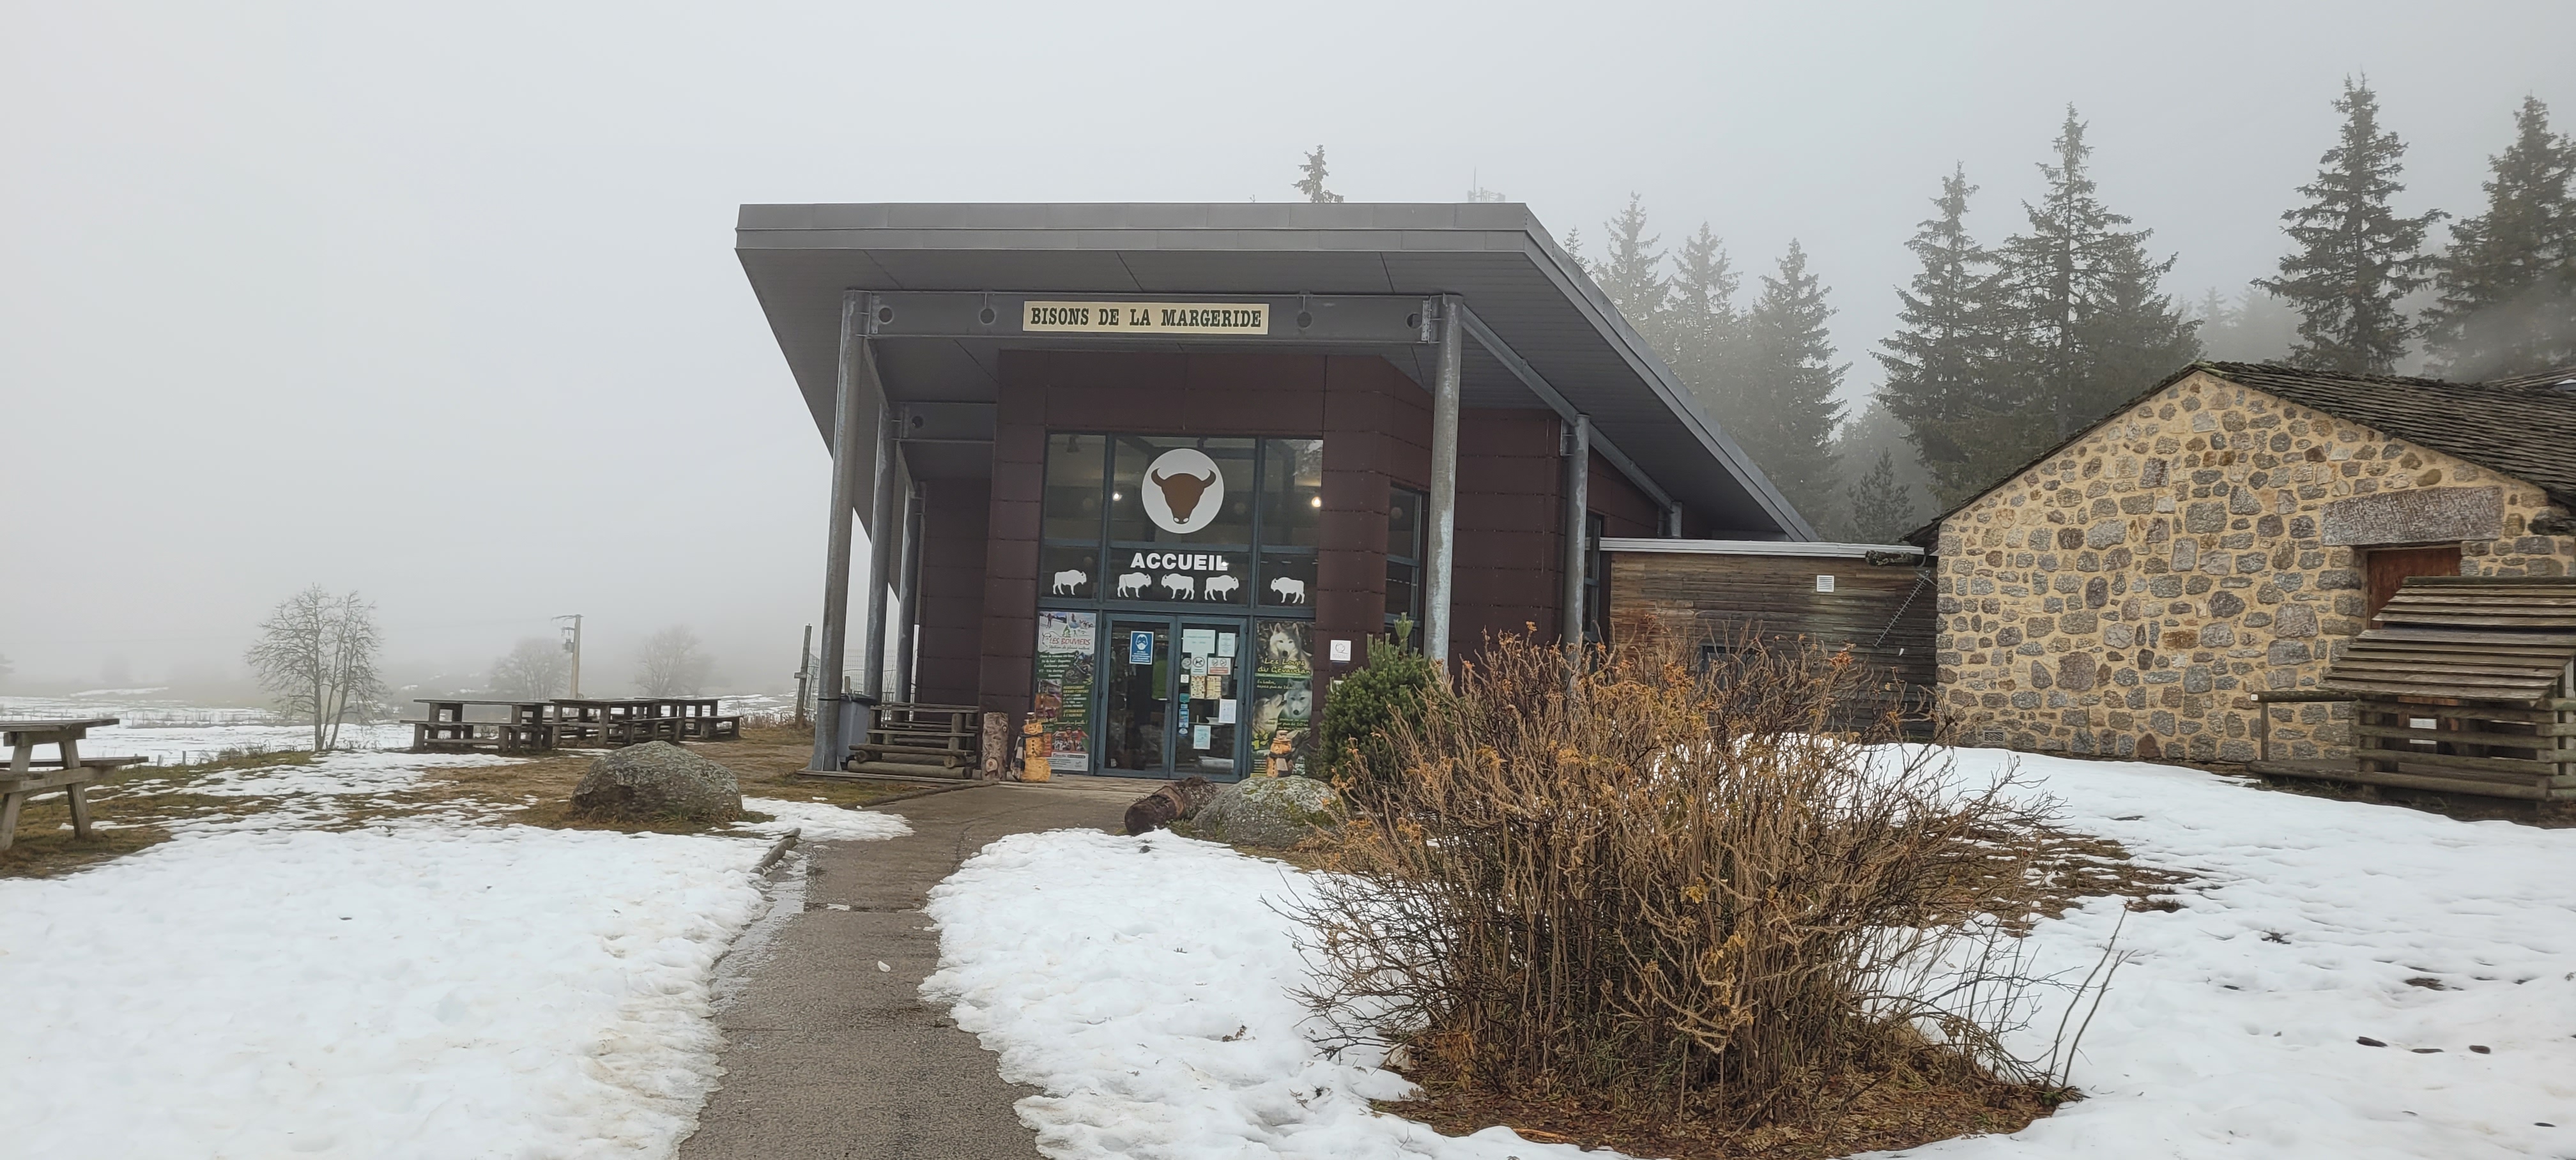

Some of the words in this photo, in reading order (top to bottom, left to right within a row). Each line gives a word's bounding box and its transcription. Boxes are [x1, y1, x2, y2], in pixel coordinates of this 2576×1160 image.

[1031, 307, 1089, 326] BISONS
[1098, 309, 1119, 326] DE
[1130, 309, 1151, 326] LA
[1160, 309, 1262, 328] MARGERIDE
[1130, 552, 1228, 571] ACCUEIL
[1282, 658, 1306, 666] Loups
[1271, 666, 1311, 675] Gévaudan
